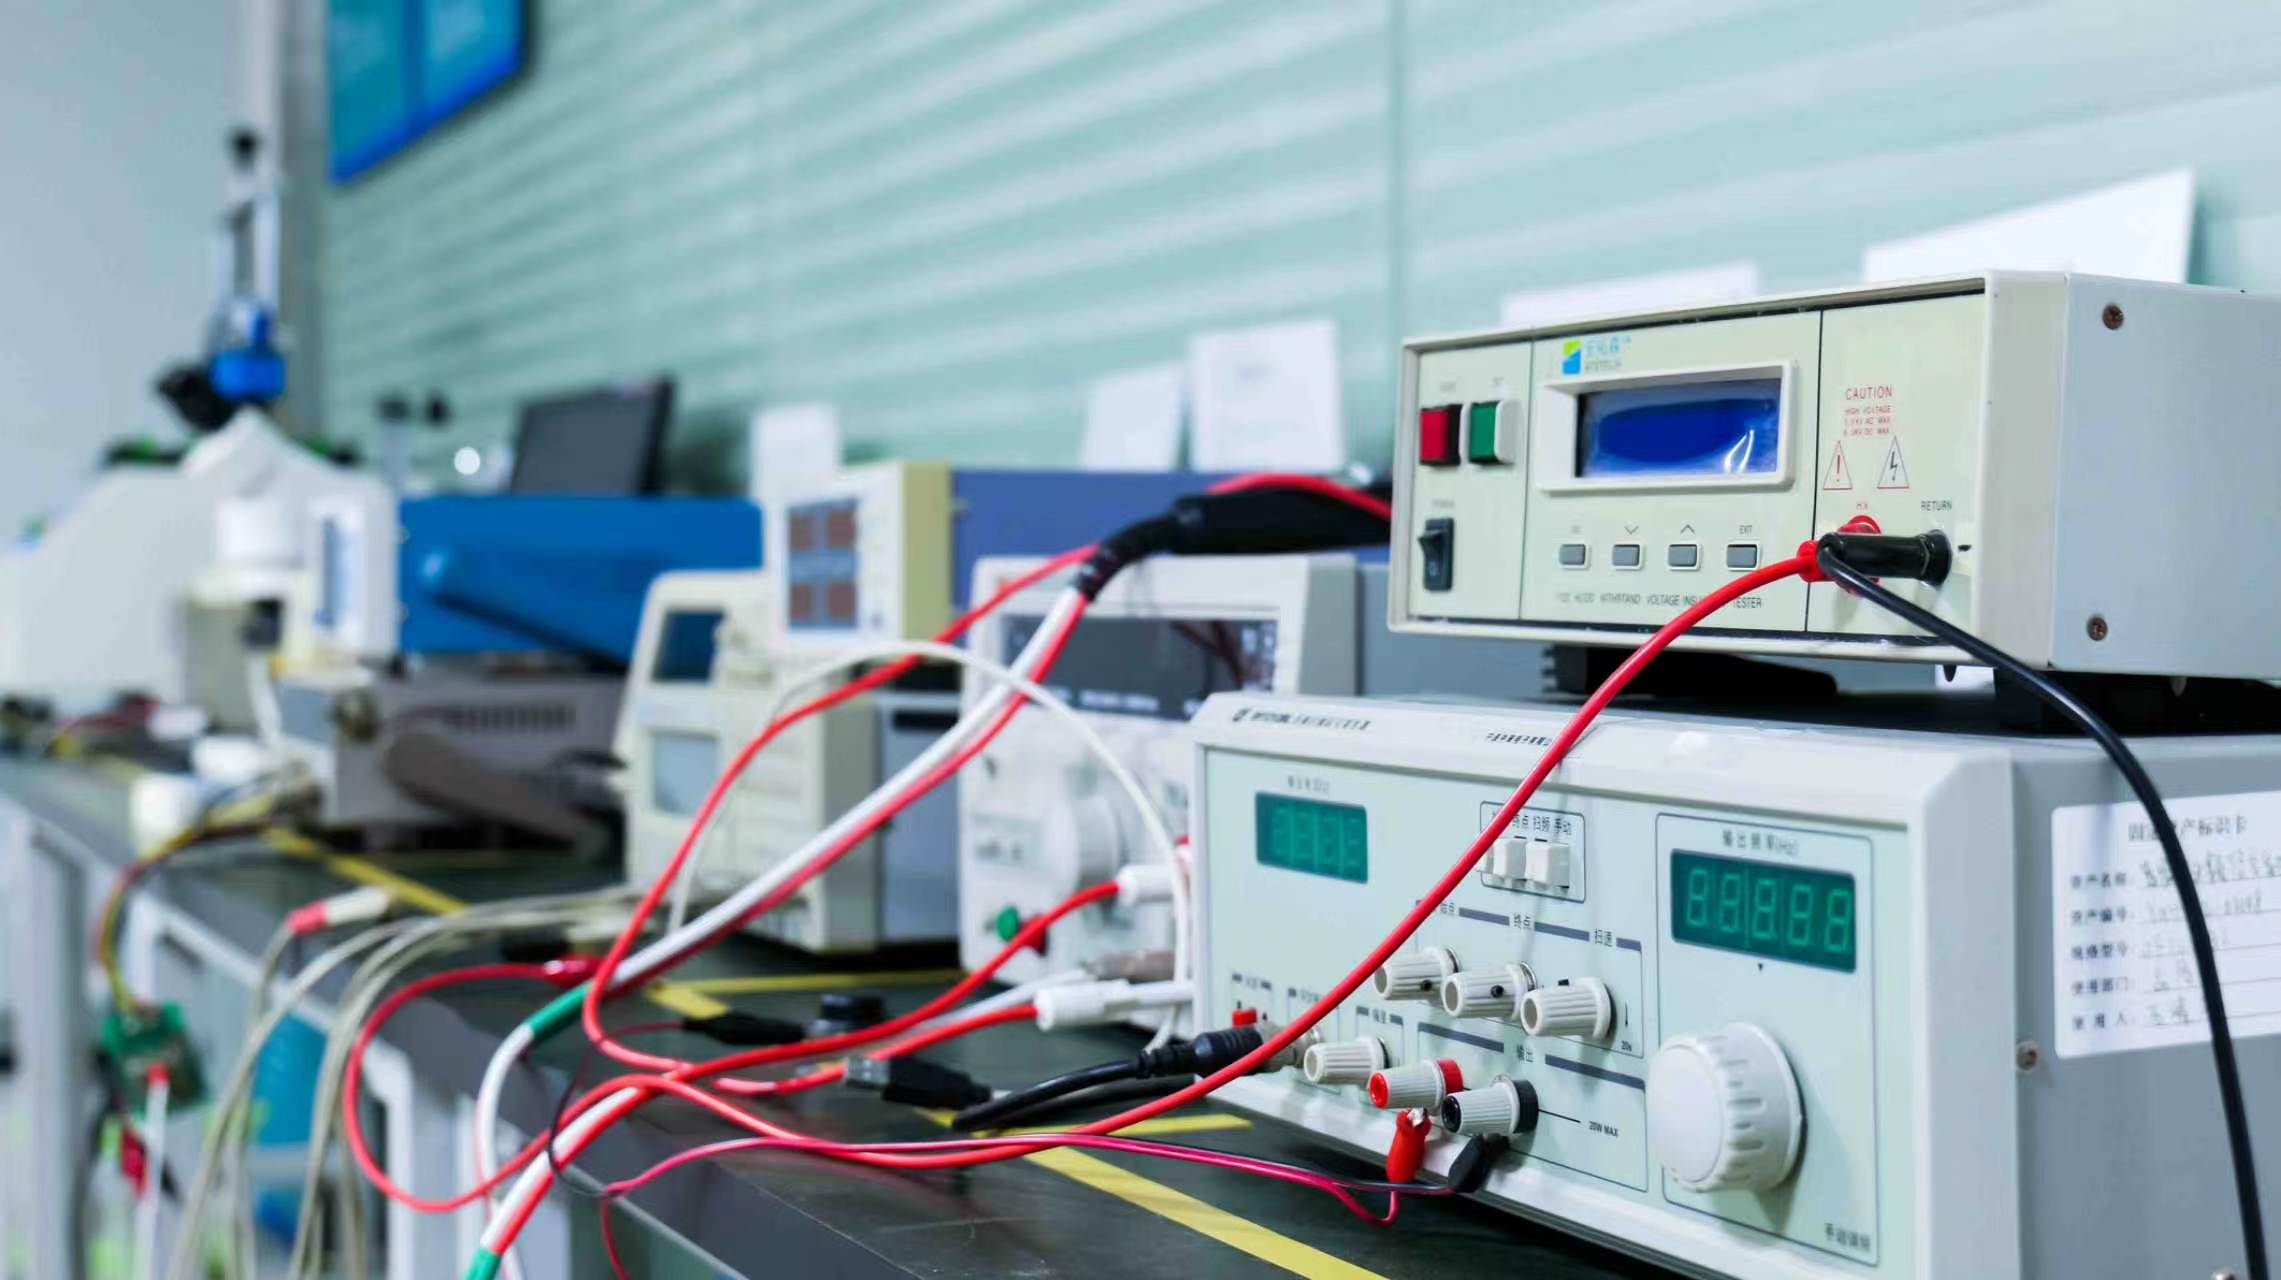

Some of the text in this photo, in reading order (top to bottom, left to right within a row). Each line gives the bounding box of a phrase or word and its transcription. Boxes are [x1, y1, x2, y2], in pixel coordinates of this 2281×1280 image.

[1845, 386, 1893, 400] CAUTION
[1862, 405, 1892, 415] VOLTAGE
[1920, 500, 1953, 511] RETURN
[1647, 593, 1680, 606] VOLTAGE
[1732, 597, 1763, 609] TESTER
[1553, 816, 1572, 837] 手动
[2127, 815, 2247, 842] 固定产标识卡
[1603, 1124, 1618, 1138] MAX
